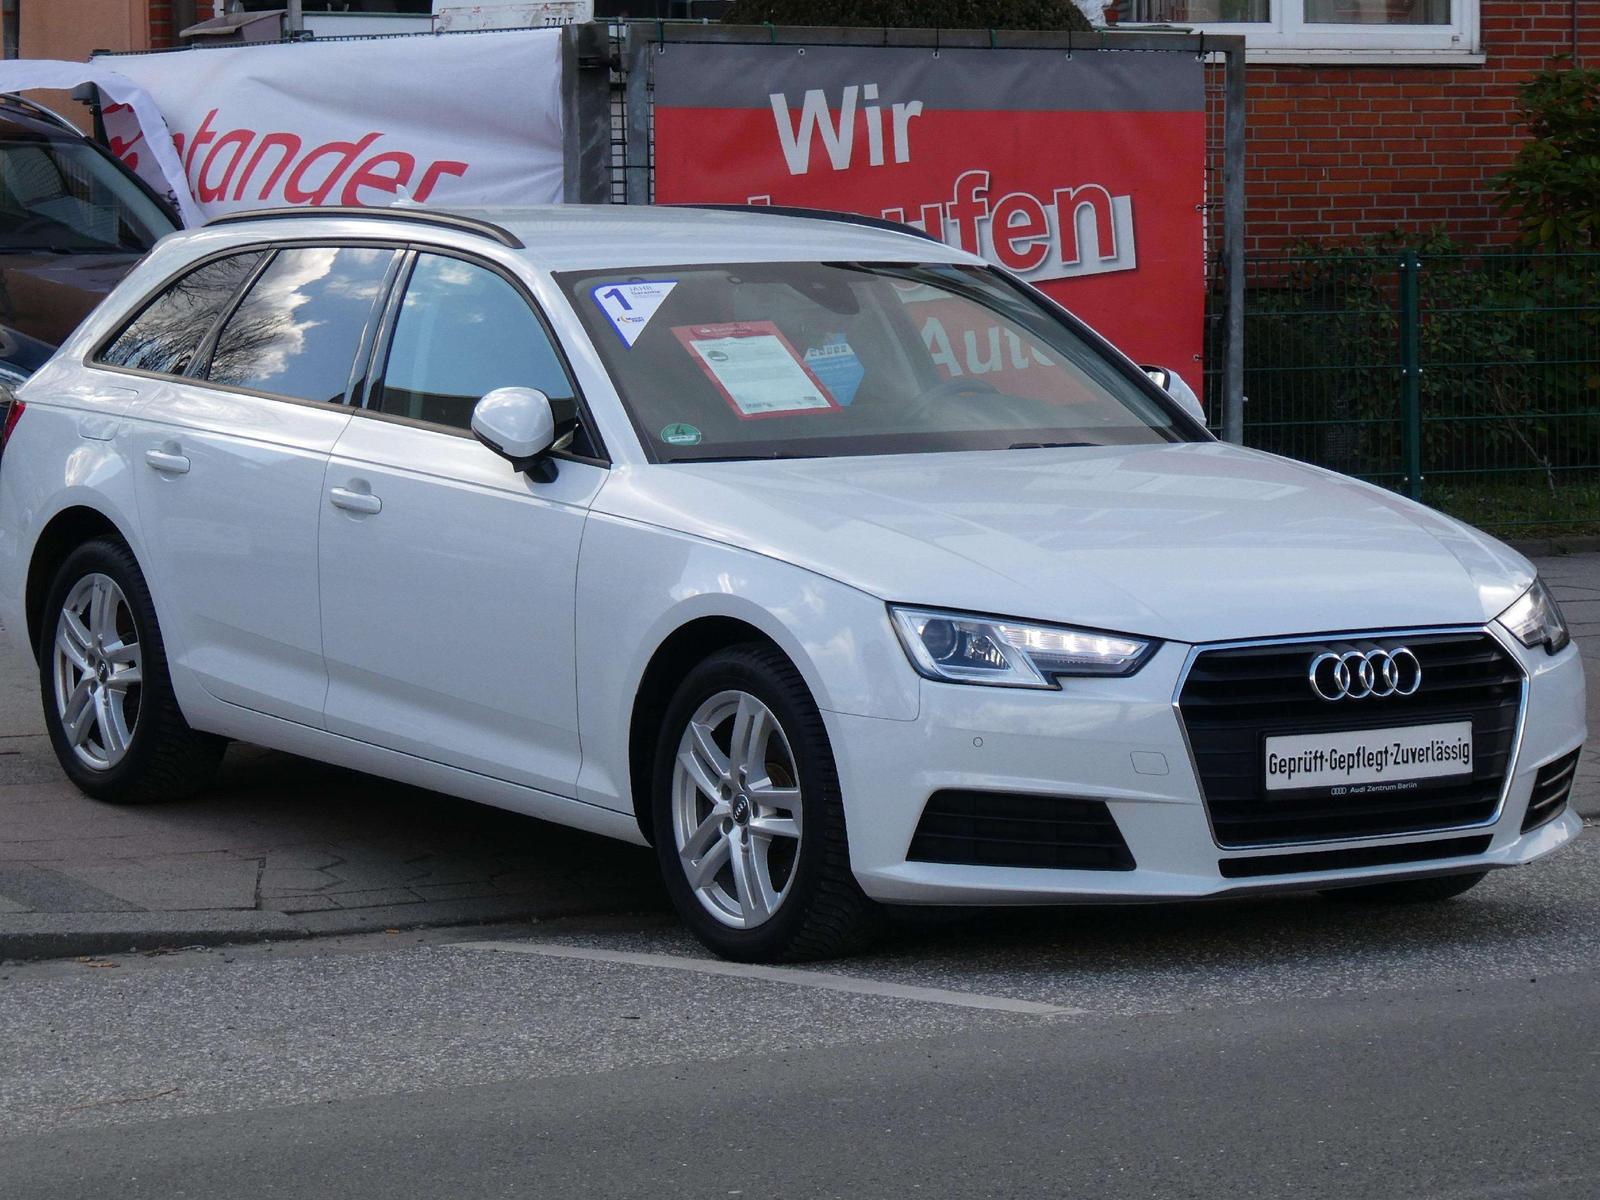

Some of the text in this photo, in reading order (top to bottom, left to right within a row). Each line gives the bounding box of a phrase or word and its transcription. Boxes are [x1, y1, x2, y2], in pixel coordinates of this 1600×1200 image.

[769, 83, 923, 175] Wir
[603, 288, 633, 311] 1
[674, 424, 686, 436] 4
[1367, 784, 1396, 793] Zentrum
[1397, 782, 1418, 790] Berlin
